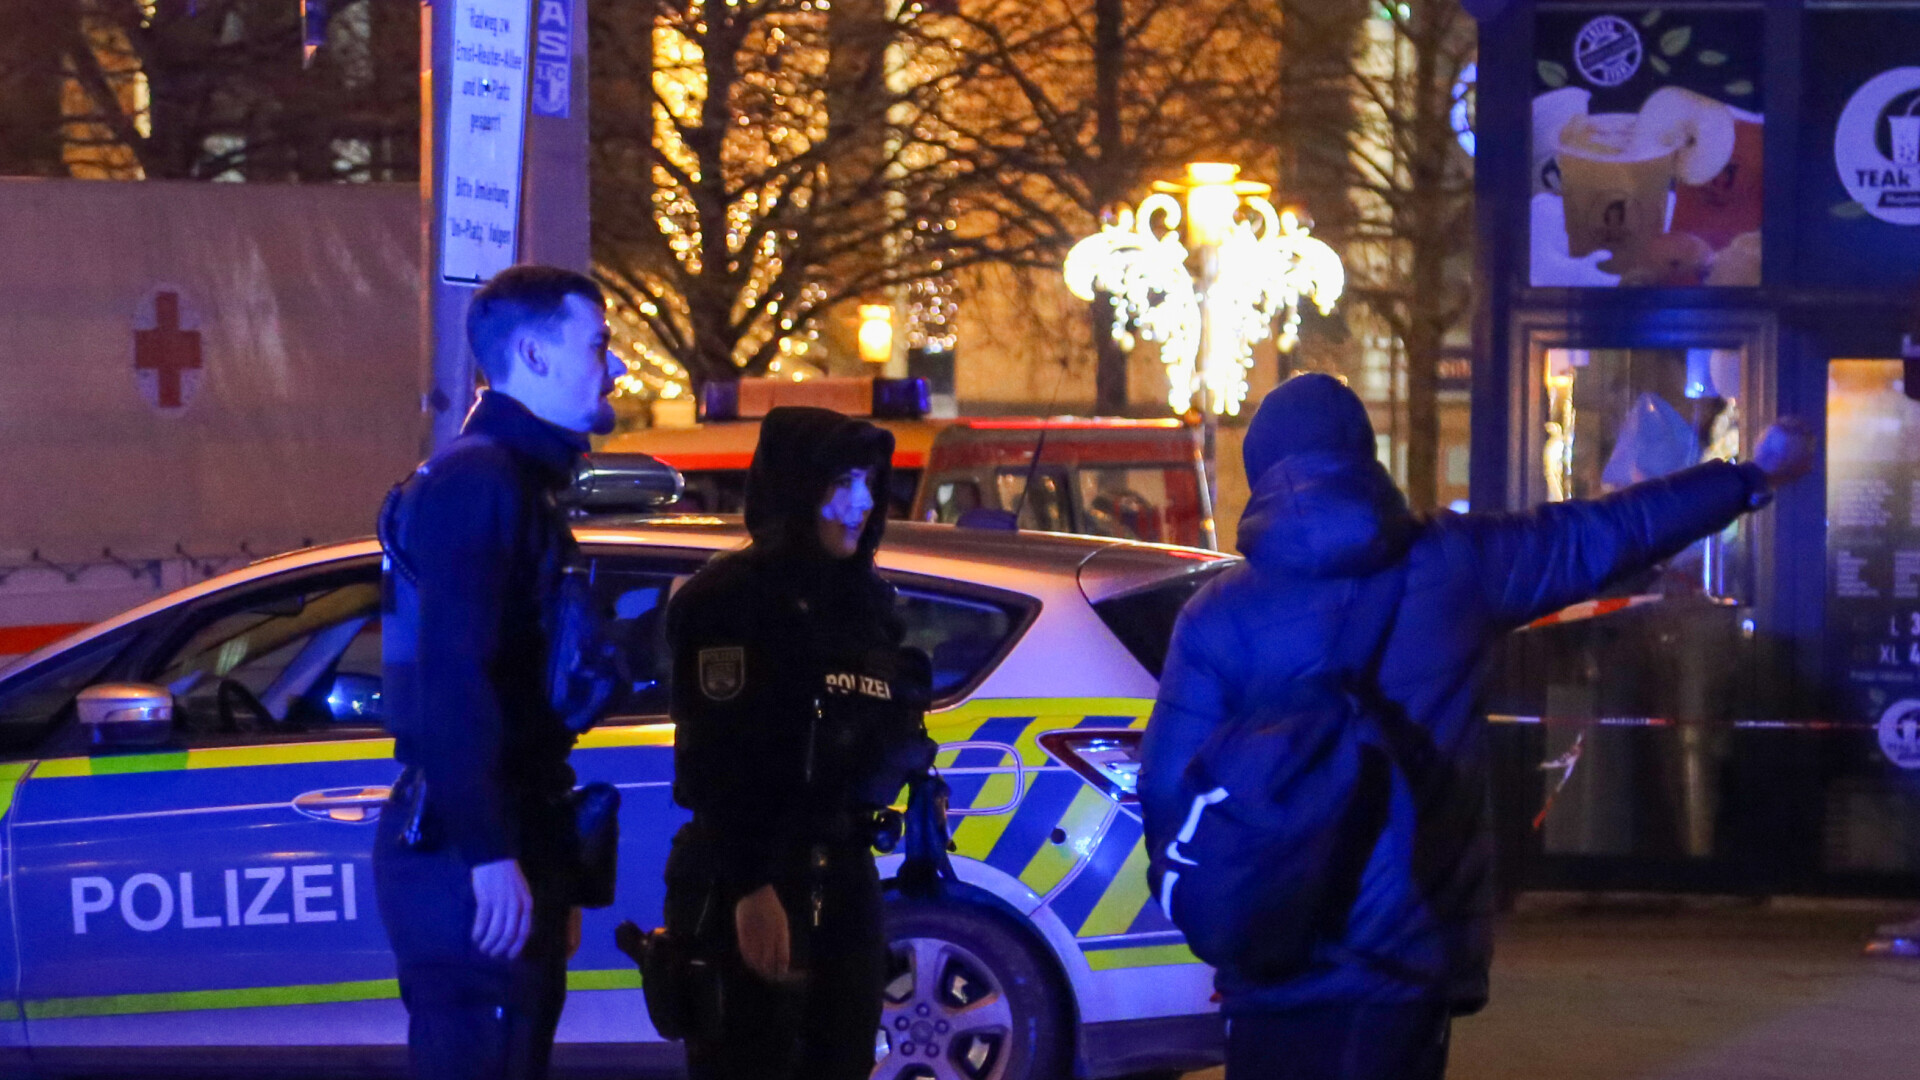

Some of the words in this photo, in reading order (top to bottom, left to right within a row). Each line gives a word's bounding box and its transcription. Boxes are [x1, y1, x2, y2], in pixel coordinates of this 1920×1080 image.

[456, 176, 473, 198] Bitte
[474, 179, 509, 209] Umleitung
[825, 673, 892, 699] POLIZEI
[71, 863, 358, 934] POLIZEI
